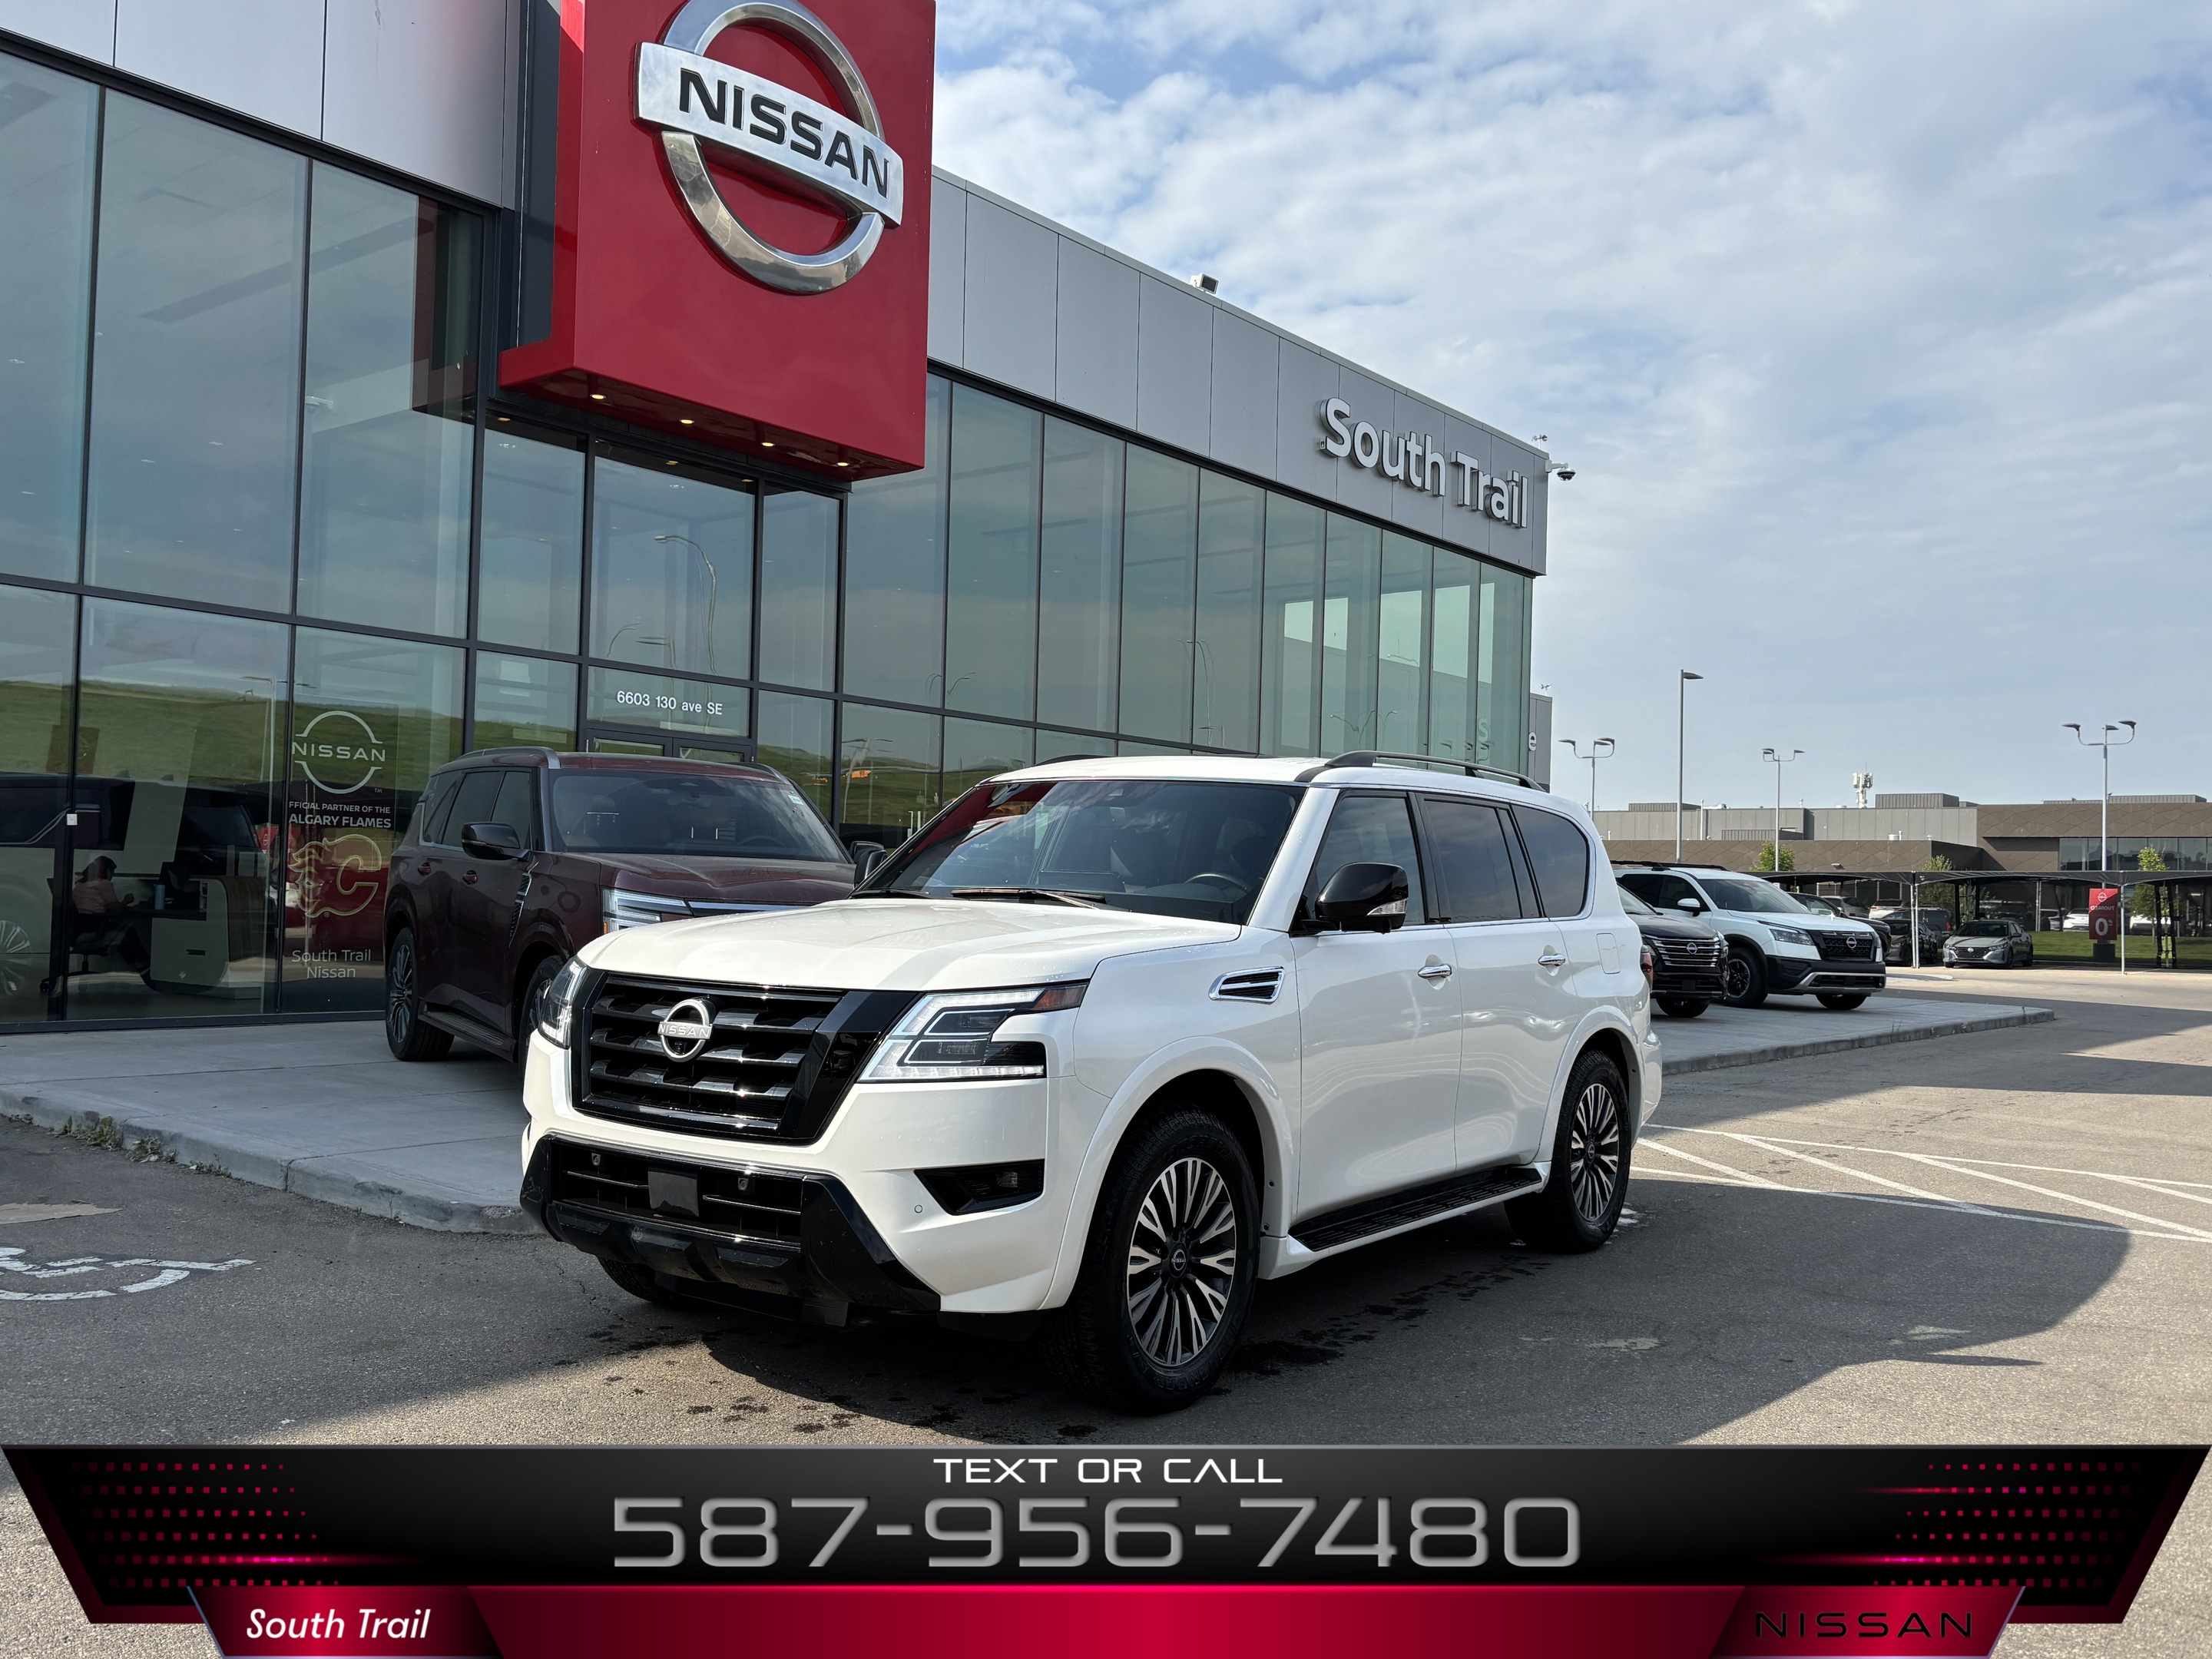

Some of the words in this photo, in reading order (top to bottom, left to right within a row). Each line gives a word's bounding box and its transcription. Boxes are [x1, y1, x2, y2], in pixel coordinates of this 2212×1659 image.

[679, 67, 889, 200] NISSAN
[1320, 397, 1446, 497] South
[1450, 450, 1528, 528] Trail
[617, 690, 651, 707] 6603
[655, 696, 677, 710] 130
[681, 701, 702, 713] ave
[707, 702, 723, 715] SE
[292, 741, 386, 762] NISSAN
[289, 801, 320, 810] FFICIAL
[322, 803, 360, 813] PARTNER
[289, 813, 339, 826] ALGARY
[342, 816, 392, 829] FLAMES
[292, 949, 337, 962] South
[341, 949, 371, 962] Trail
[307, 966, 356, 979] Nissan
[658, 1023, 710, 1038] NISSAN
